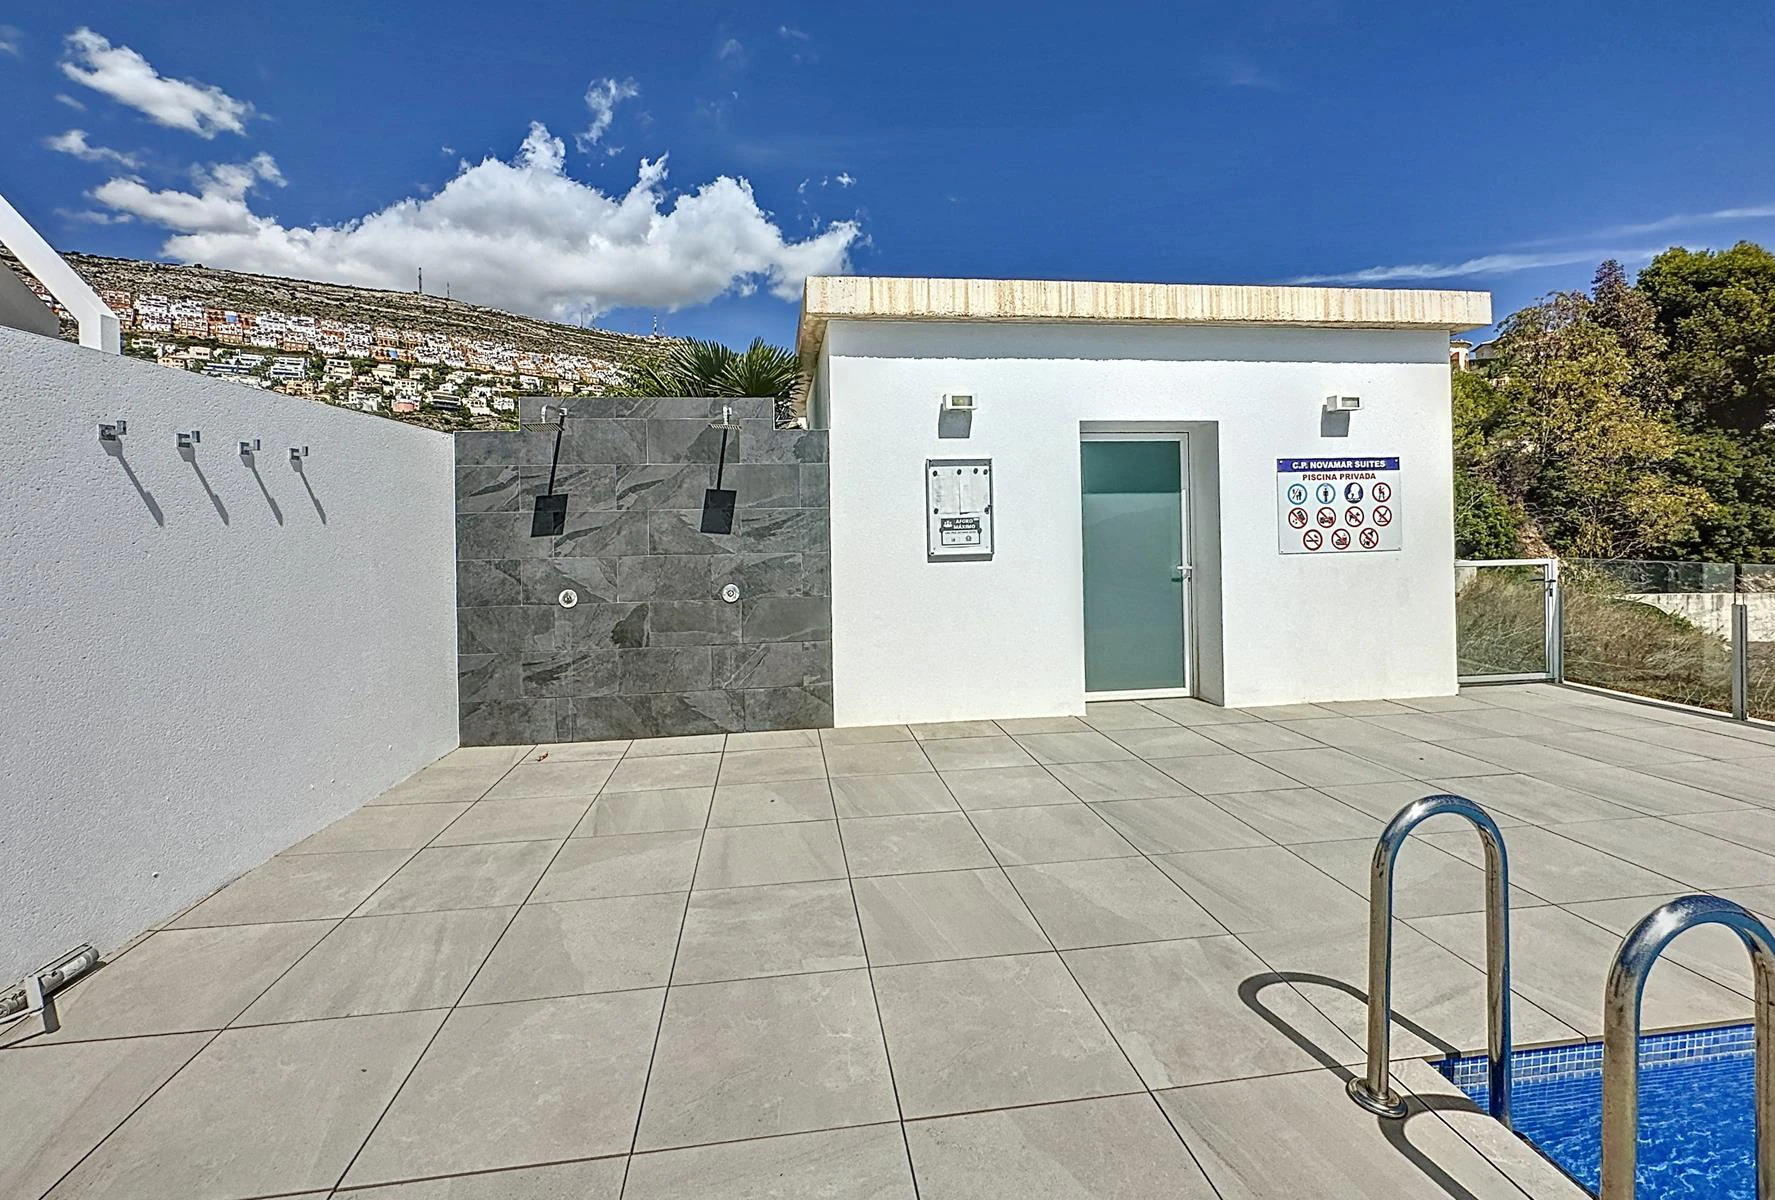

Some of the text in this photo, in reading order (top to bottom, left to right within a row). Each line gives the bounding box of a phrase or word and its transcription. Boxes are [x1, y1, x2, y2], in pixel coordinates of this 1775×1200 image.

[1292, 460, 1386, 469] C.P. NOVAMAR SUITES
[1302, 472, 1376, 481] PISCINA PRIVADA
